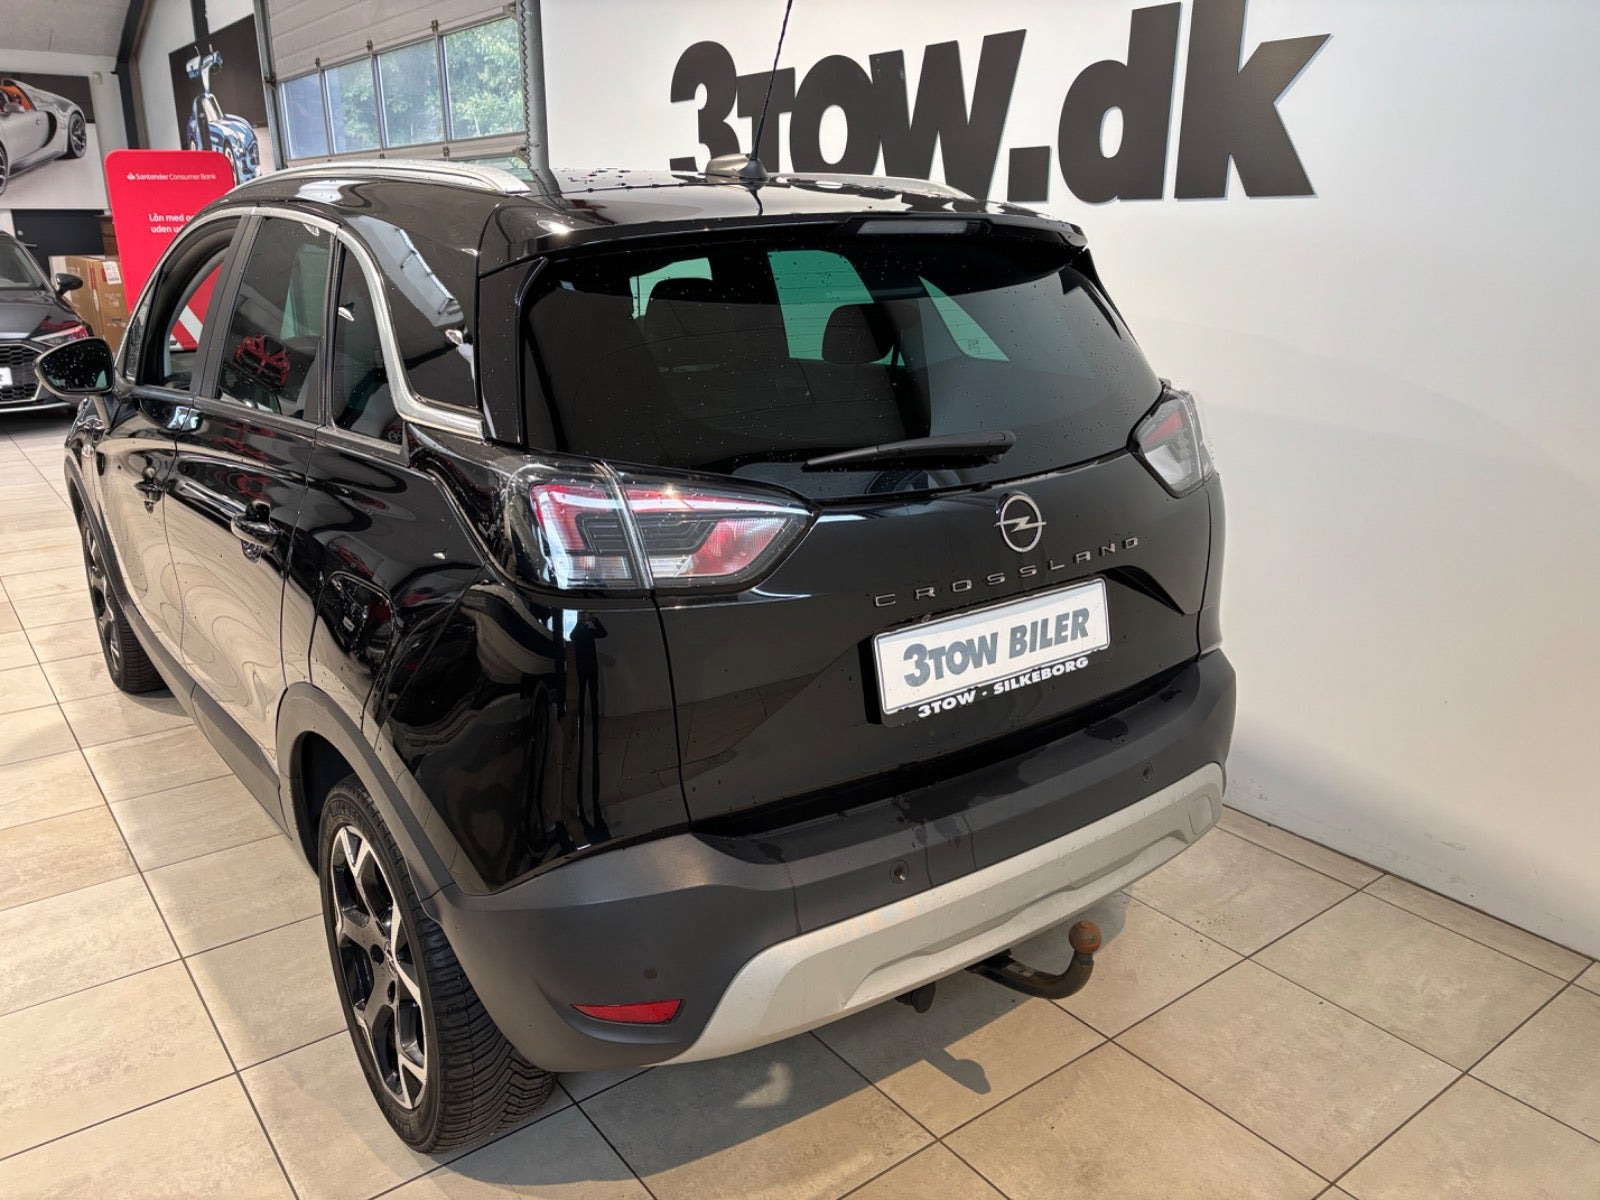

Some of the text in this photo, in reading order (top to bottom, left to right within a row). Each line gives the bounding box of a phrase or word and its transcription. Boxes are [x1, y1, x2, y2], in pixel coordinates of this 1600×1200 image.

[149, 213, 164, 222] Lån
[165, 213, 184, 222] med
[151, 225, 172, 233] uden
[874, 536, 1138, 607] CROSSLAND
[903, 608, 1090, 688] 3TOW BILER
[918, 657, 1088, 718] 3TOW SILKEBORG
